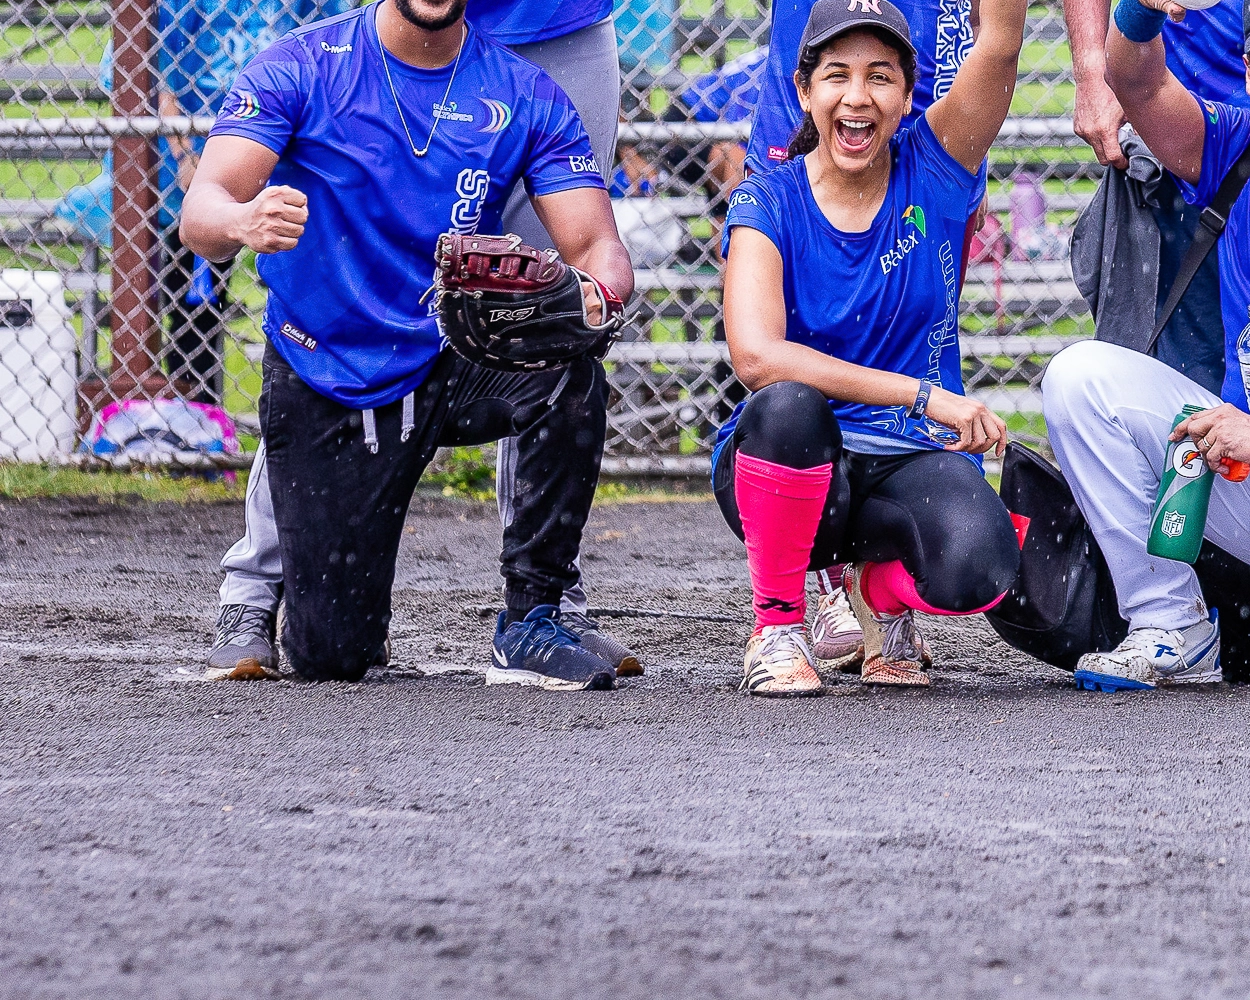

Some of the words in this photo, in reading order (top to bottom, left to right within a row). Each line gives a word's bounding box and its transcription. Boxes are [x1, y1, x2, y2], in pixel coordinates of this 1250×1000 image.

[304, 337, 318, 350] M
[1171, 440, 1206, 479] G
[1162, 519, 1184, 536] NFL
